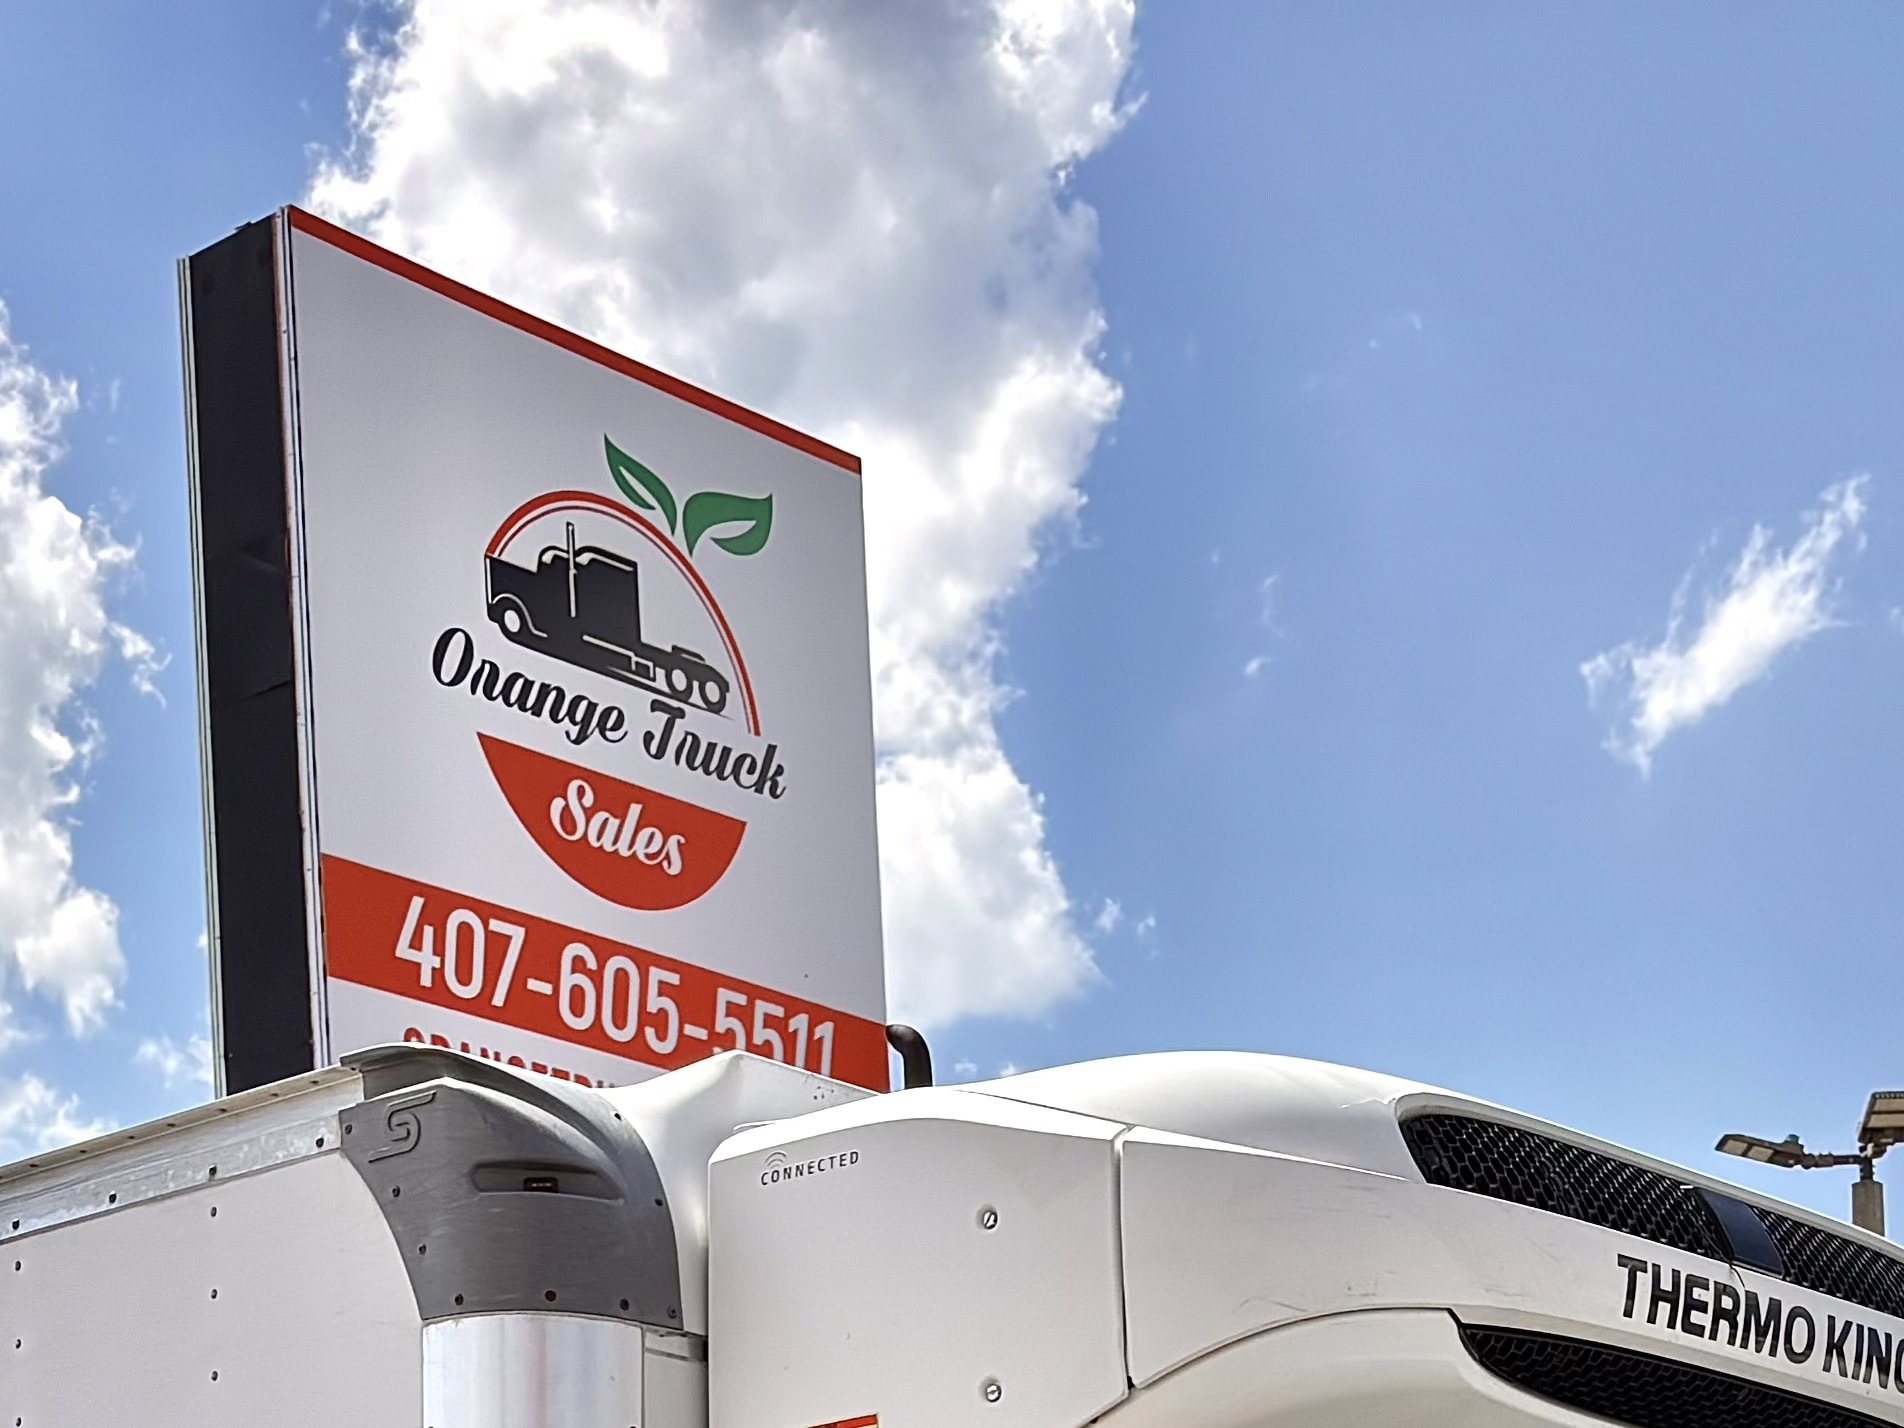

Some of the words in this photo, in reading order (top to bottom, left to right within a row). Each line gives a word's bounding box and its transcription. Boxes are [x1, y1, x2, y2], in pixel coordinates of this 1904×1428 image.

[431, 626, 629, 746] Orange
[642, 698, 788, 800] Truck
[549, 778, 686, 877] Sales
[394, 895, 836, 1080] 407-605-5511
[760, 1150, 860, 1186] CONNECTED
[1616, 1252, 1816, 1365] THERMO
